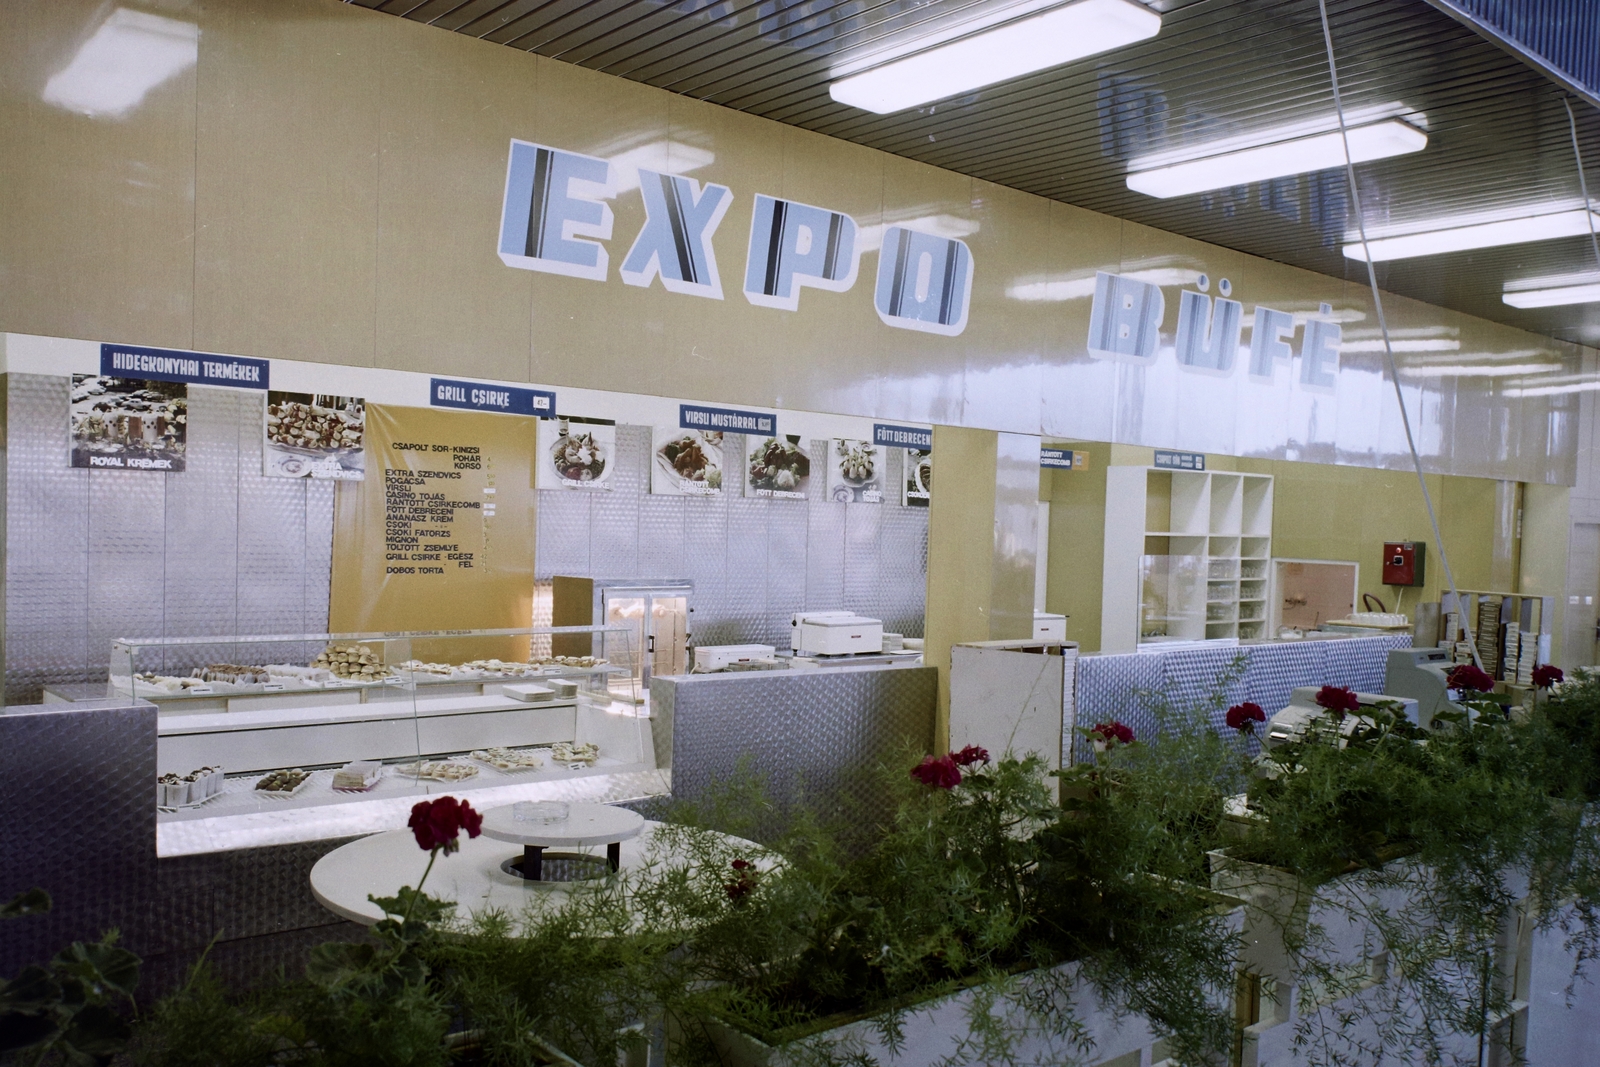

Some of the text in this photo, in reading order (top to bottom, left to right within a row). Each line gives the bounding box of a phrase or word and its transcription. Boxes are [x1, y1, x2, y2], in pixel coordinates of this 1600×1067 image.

[497, 138, 1343, 396] EXPO BÜFÉ
[113, 352, 260, 382] HIDEGKONYHAI TERMÉKEK
[437, 385, 510, 407] GRILL CSIRKE
[685, 410, 710, 426] VIRSLI
[710, 412, 758, 430] MUSTÁRRAL
[392, 442, 429, 452] CSAPOLT
[90, 456, 124, 467] ROYAL
[312, 461, 342, 470] EXTRA
[311, 469, 361, 478] SZENDVICS
[385, 469, 462, 480] EXTRA SZENDVICS
[386, 484, 412, 492] VIRSLI
[385, 491, 416, 500] CASINO
[427, 501, 481, 509] CSIRKECOMB
[408, 507, 454, 515] DEBRECENI
[385, 521, 412, 529] CSOKI
[385, 528, 412, 536] CSOKI
[385, 536, 419, 544] MIGNON
[423, 544, 459, 552] ZSEMLYE
[385, 553, 409, 561] GRILL
[411, 553, 441, 561] CSIRKE
[386, 566, 444, 575] DOBOS TORTA
